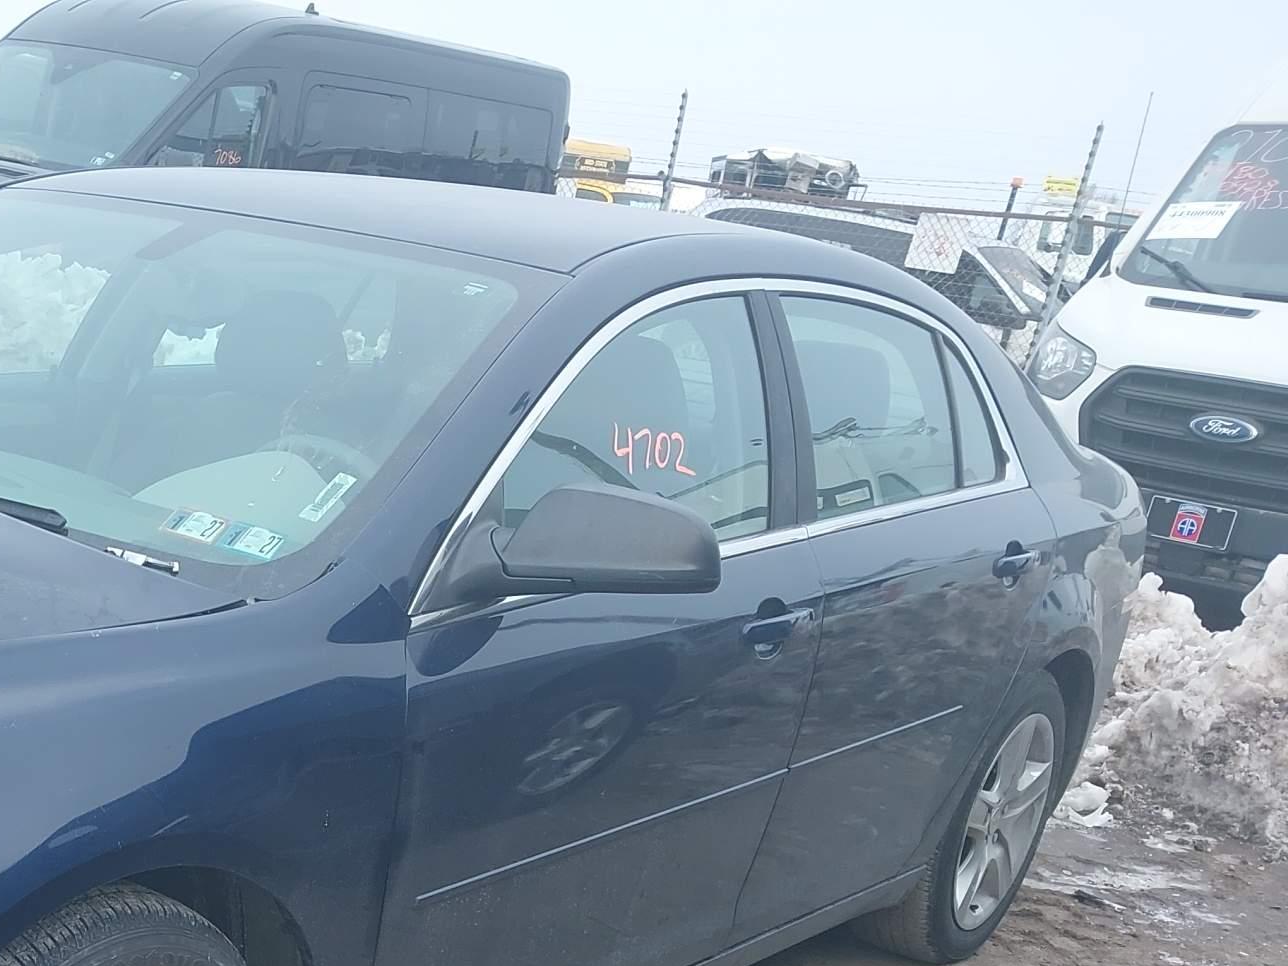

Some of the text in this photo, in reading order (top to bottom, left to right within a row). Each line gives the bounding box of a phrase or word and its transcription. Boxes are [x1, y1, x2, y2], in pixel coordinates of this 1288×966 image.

[214, 148, 242, 166] 7086
[1202, 419, 1241, 436] Ford
[613, 421, 697, 476] 4702
[199, 519, 225, 538] 27
[258, 534, 284, 554] 27
